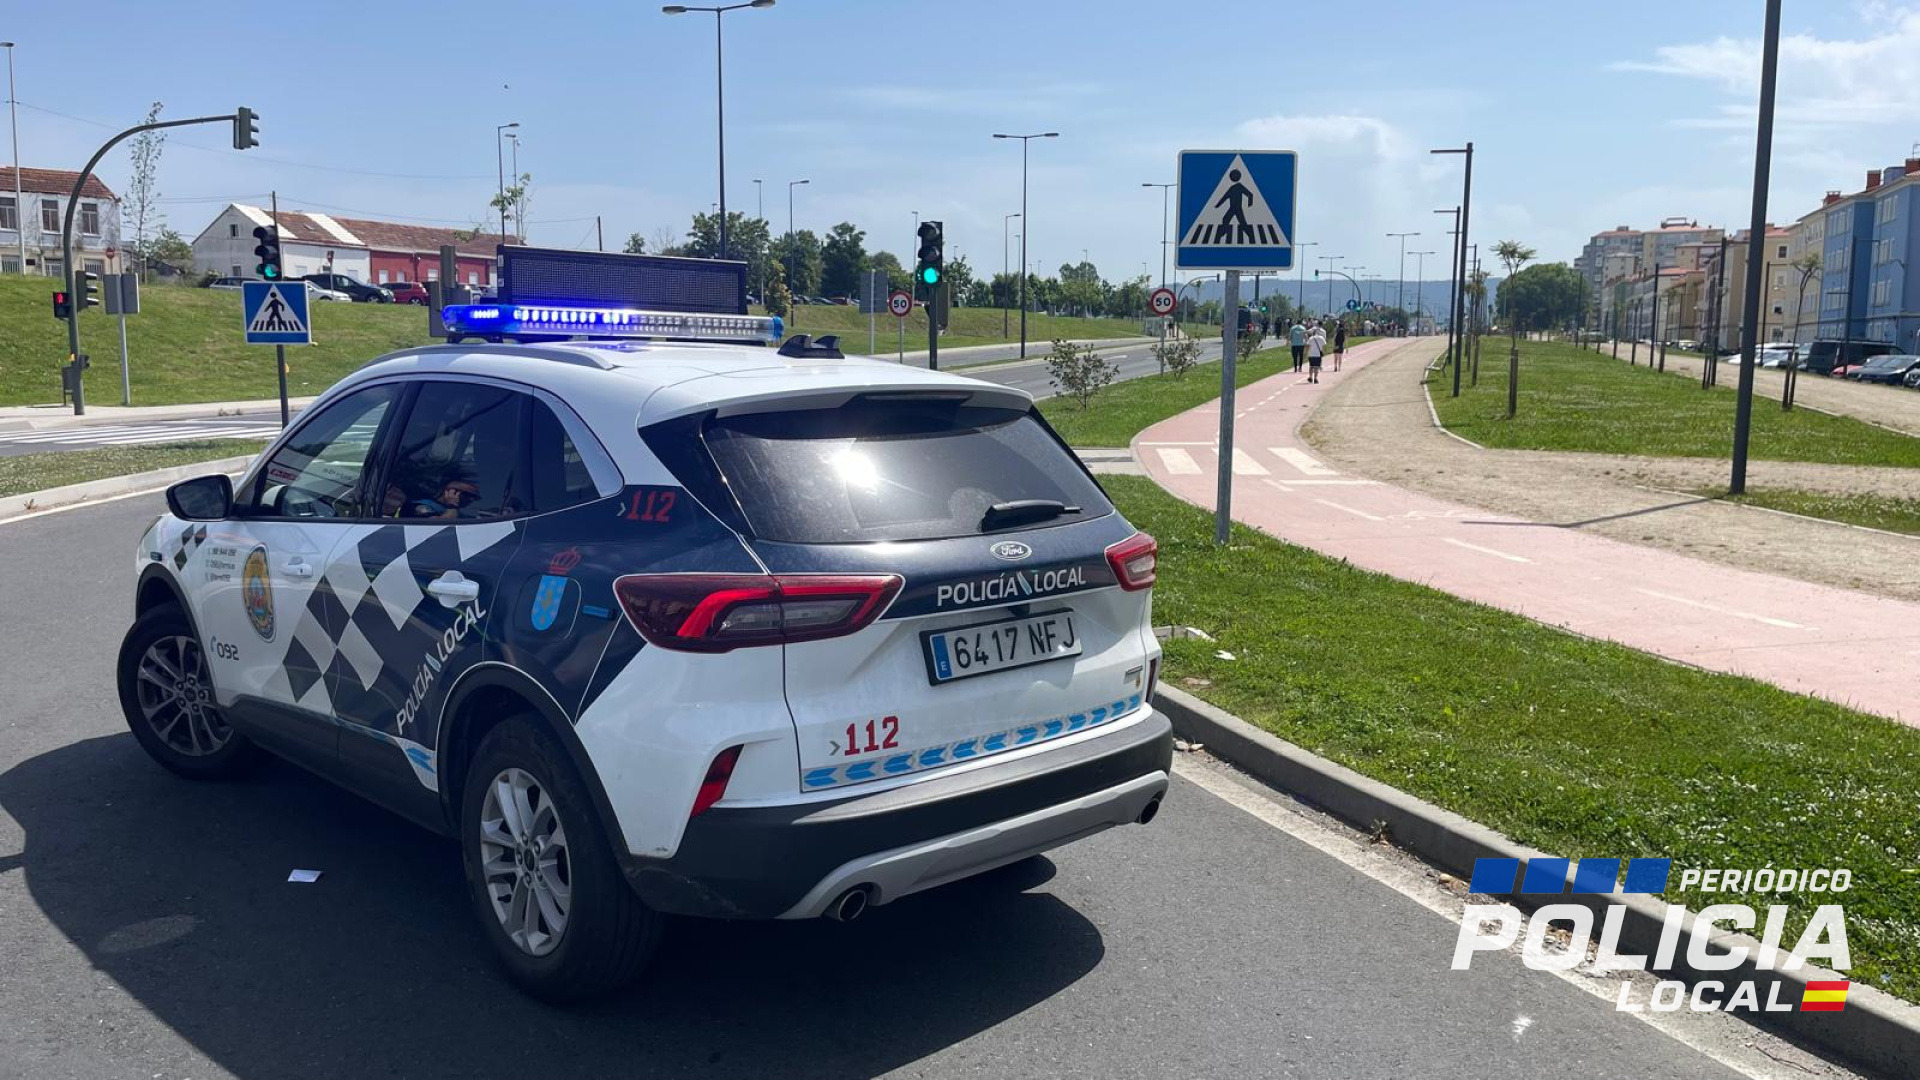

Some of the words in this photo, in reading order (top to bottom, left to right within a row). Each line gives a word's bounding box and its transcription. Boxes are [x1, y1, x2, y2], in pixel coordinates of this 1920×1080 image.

[893, 299, 907, 308] 50
[1155, 297, 1171, 307] 50
[626, 489, 676, 522] 112
[936, 572, 1019, 606] POLICÍA
[1033, 566, 1087, 593] LOCAL
[436, 598, 487, 662] LOCAL
[953, 626, 1019, 669] 6417
[1027, 617, 1075, 655] NFJ
[216, 642, 240, 661] 092
[940, 660, 948, 671] E
[844, 715, 899, 756] 112
